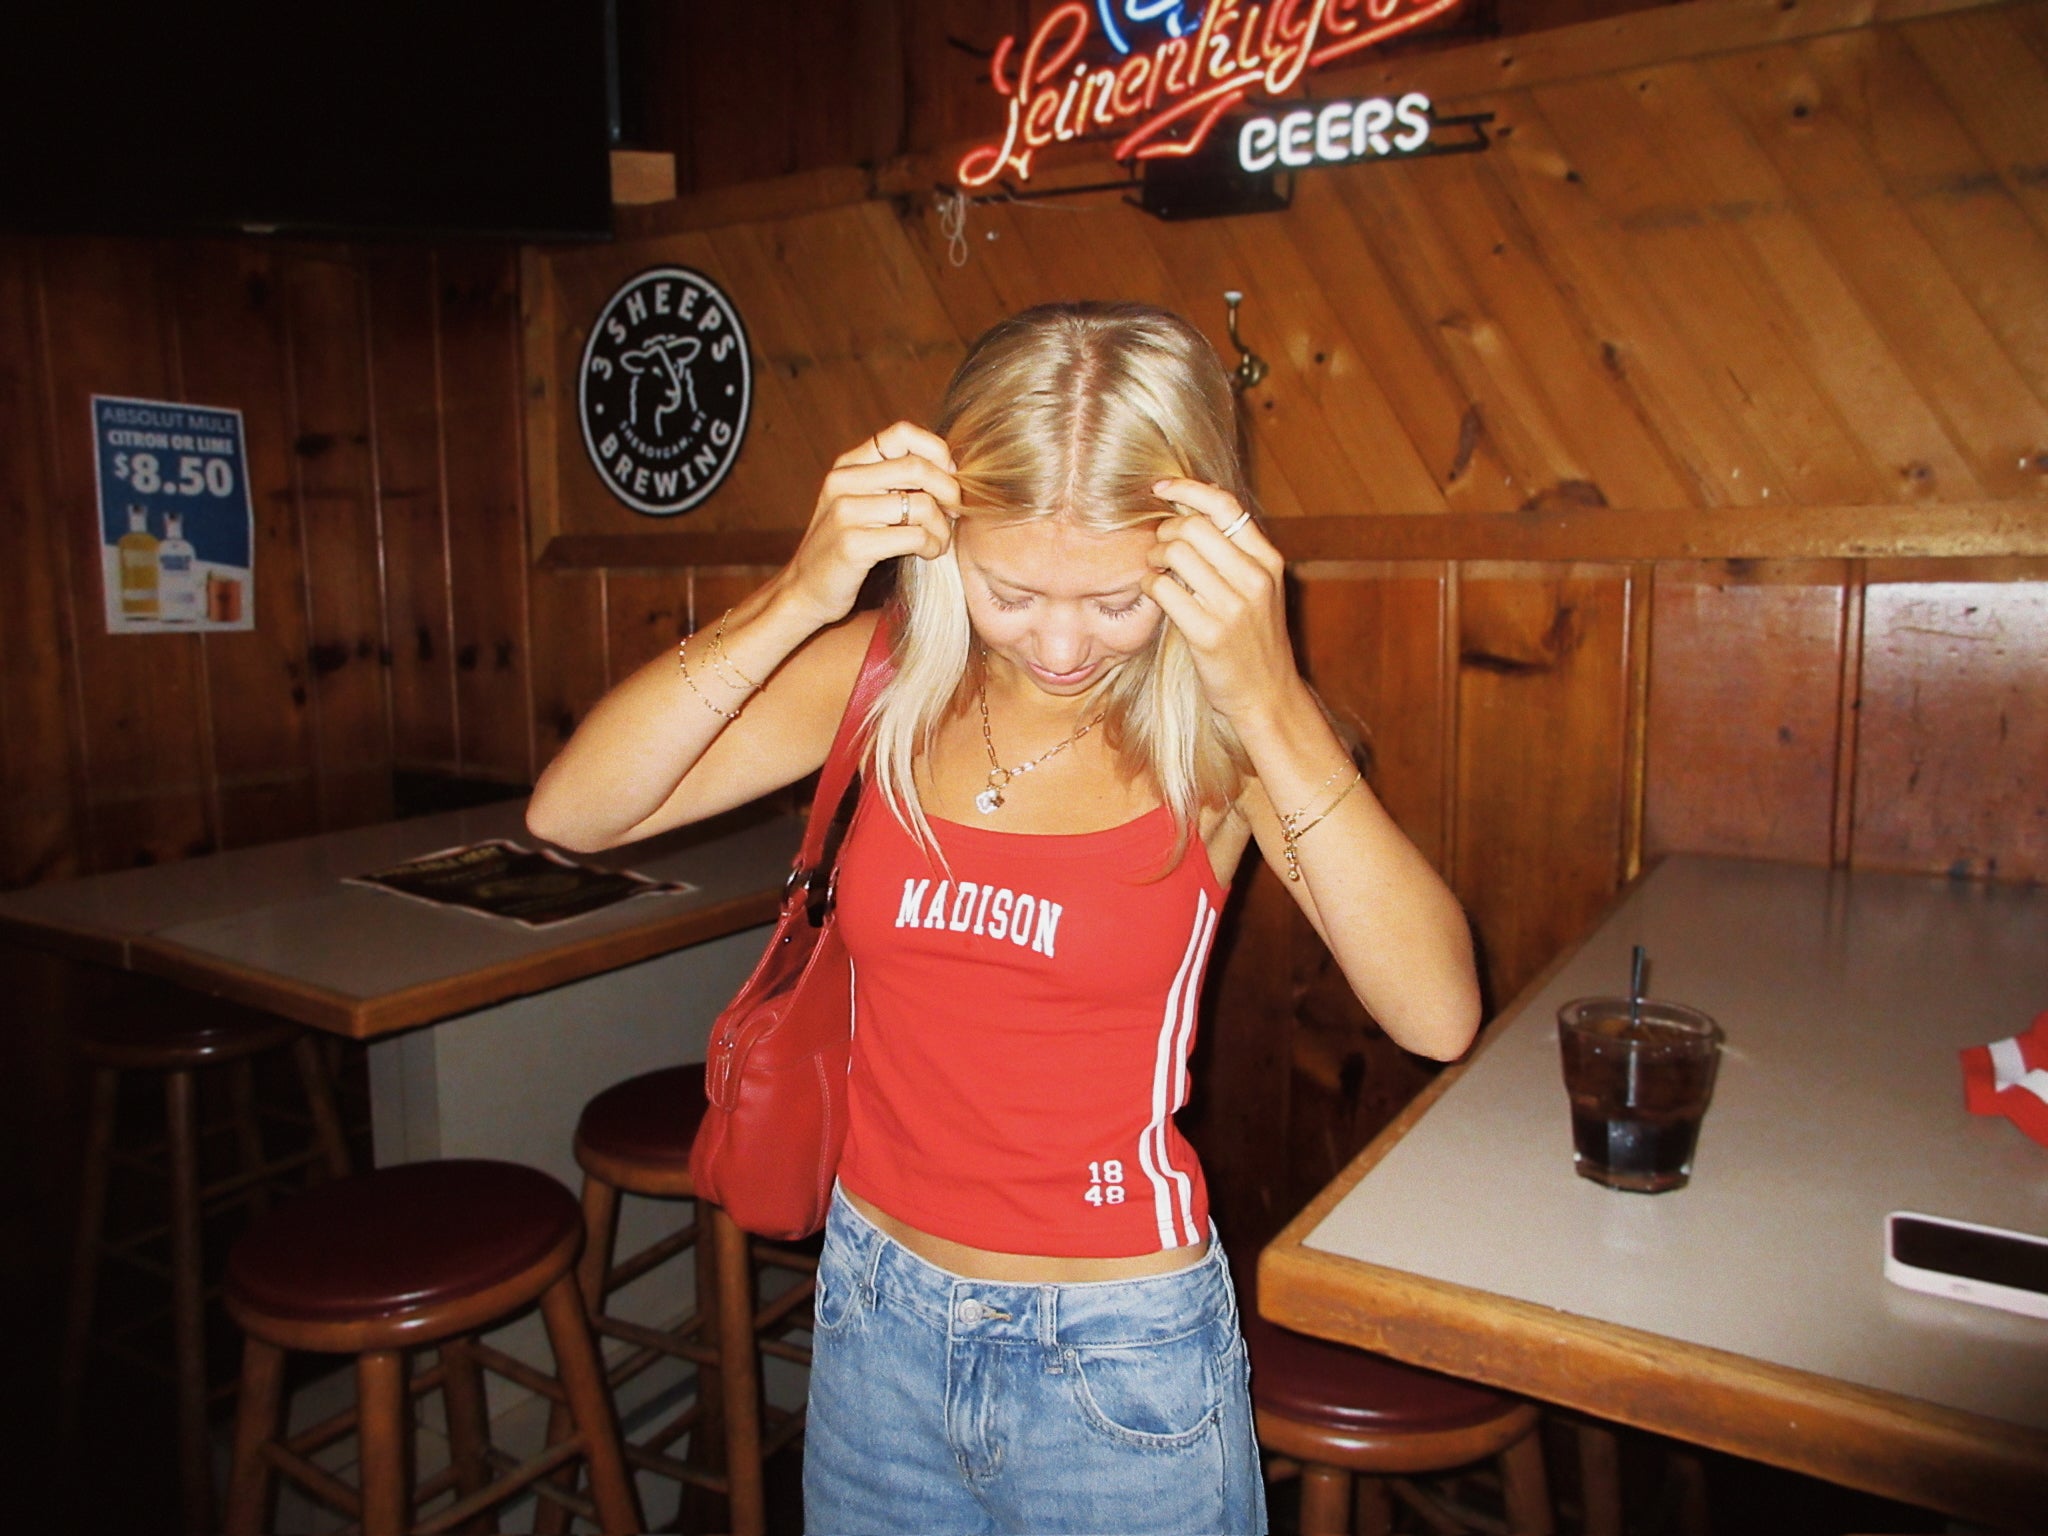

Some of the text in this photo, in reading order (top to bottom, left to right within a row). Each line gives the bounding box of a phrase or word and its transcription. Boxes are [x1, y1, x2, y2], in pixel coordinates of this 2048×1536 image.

[591, 283, 736, 381] 3 SHEEPS
[103, 407, 233, 432] ABSOLUT MULE
[108, 431, 234, 453] CITRON OR LIME
[600, 419, 732, 498] BREWING
[114, 453, 234, 497] $8.50
[894, 878, 1064, 959] MADISON
[1088, 1159, 1124, 1184] 18
[1084, 1185, 1125, 1208] 48
